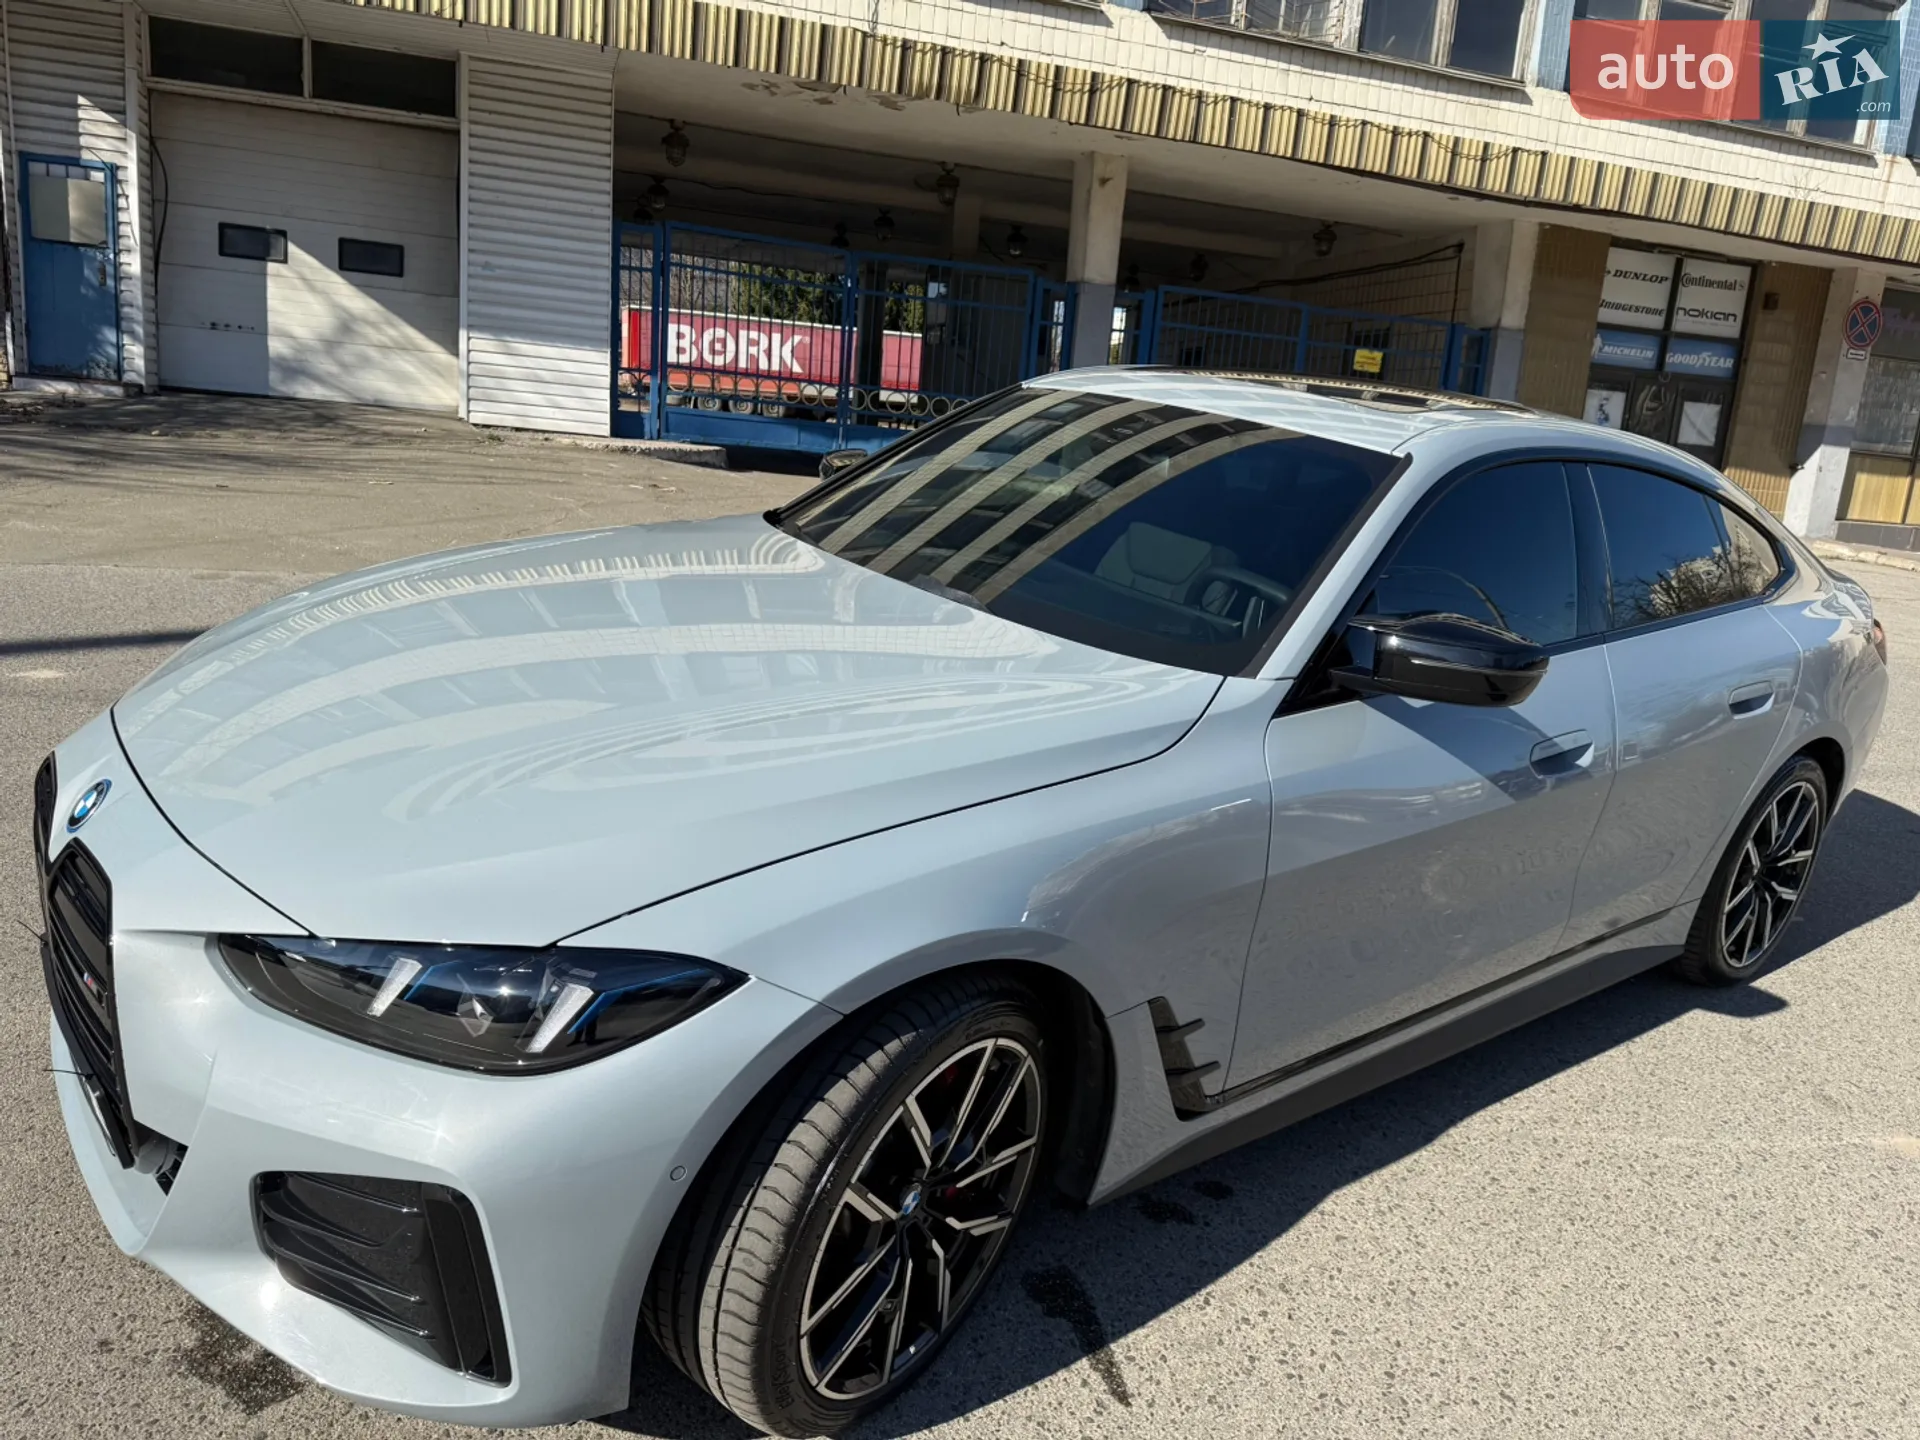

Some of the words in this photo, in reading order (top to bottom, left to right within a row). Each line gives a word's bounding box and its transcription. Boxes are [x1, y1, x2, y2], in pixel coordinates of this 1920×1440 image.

[1613, 269, 1668, 284] DUNLOP
[1681, 272, 1737, 291] Continental
[667, 323, 803, 373] BORK
[1602, 345, 1654, 358] MICHELIN
[1666, 351, 1734, 368] GOODYEAR
